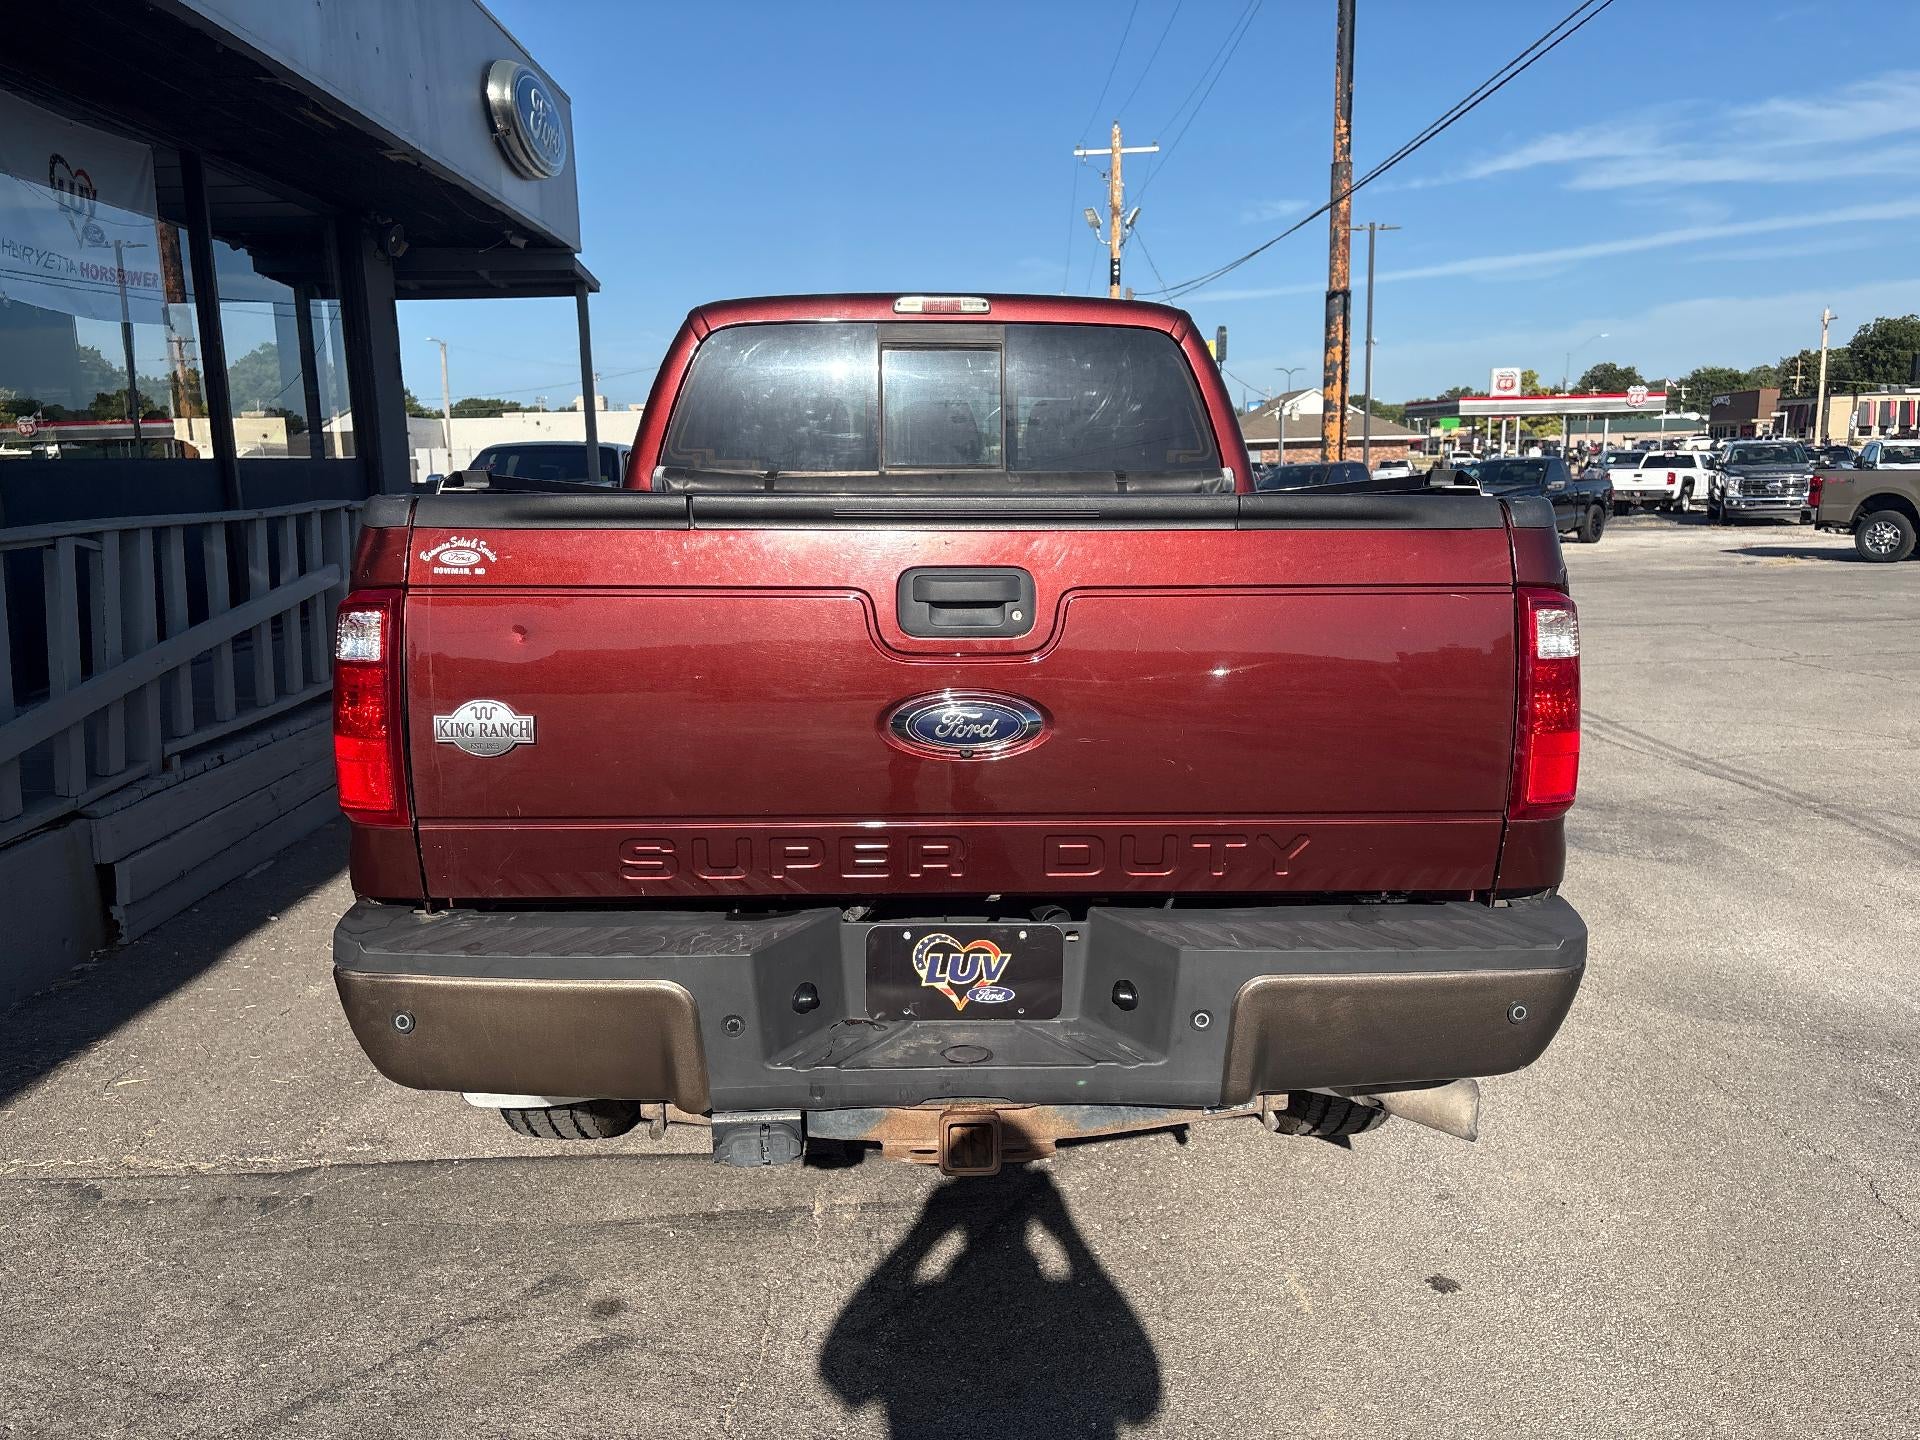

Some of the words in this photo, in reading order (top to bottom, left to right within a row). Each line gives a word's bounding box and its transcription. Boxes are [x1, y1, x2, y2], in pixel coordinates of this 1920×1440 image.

[530, 88, 561, 157] Ford
[79, 261, 159, 289] HORSOWER
[438, 720, 475, 738] KING
[480, 720, 531, 738] RANCH
[935, 711, 998, 739] Ford
[619, 834, 965, 879] SUPER
[1043, 834, 1310, 876] DUTY
[921, 953, 1012, 986] LUV
[975, 988, 1006, 1002] Ford
